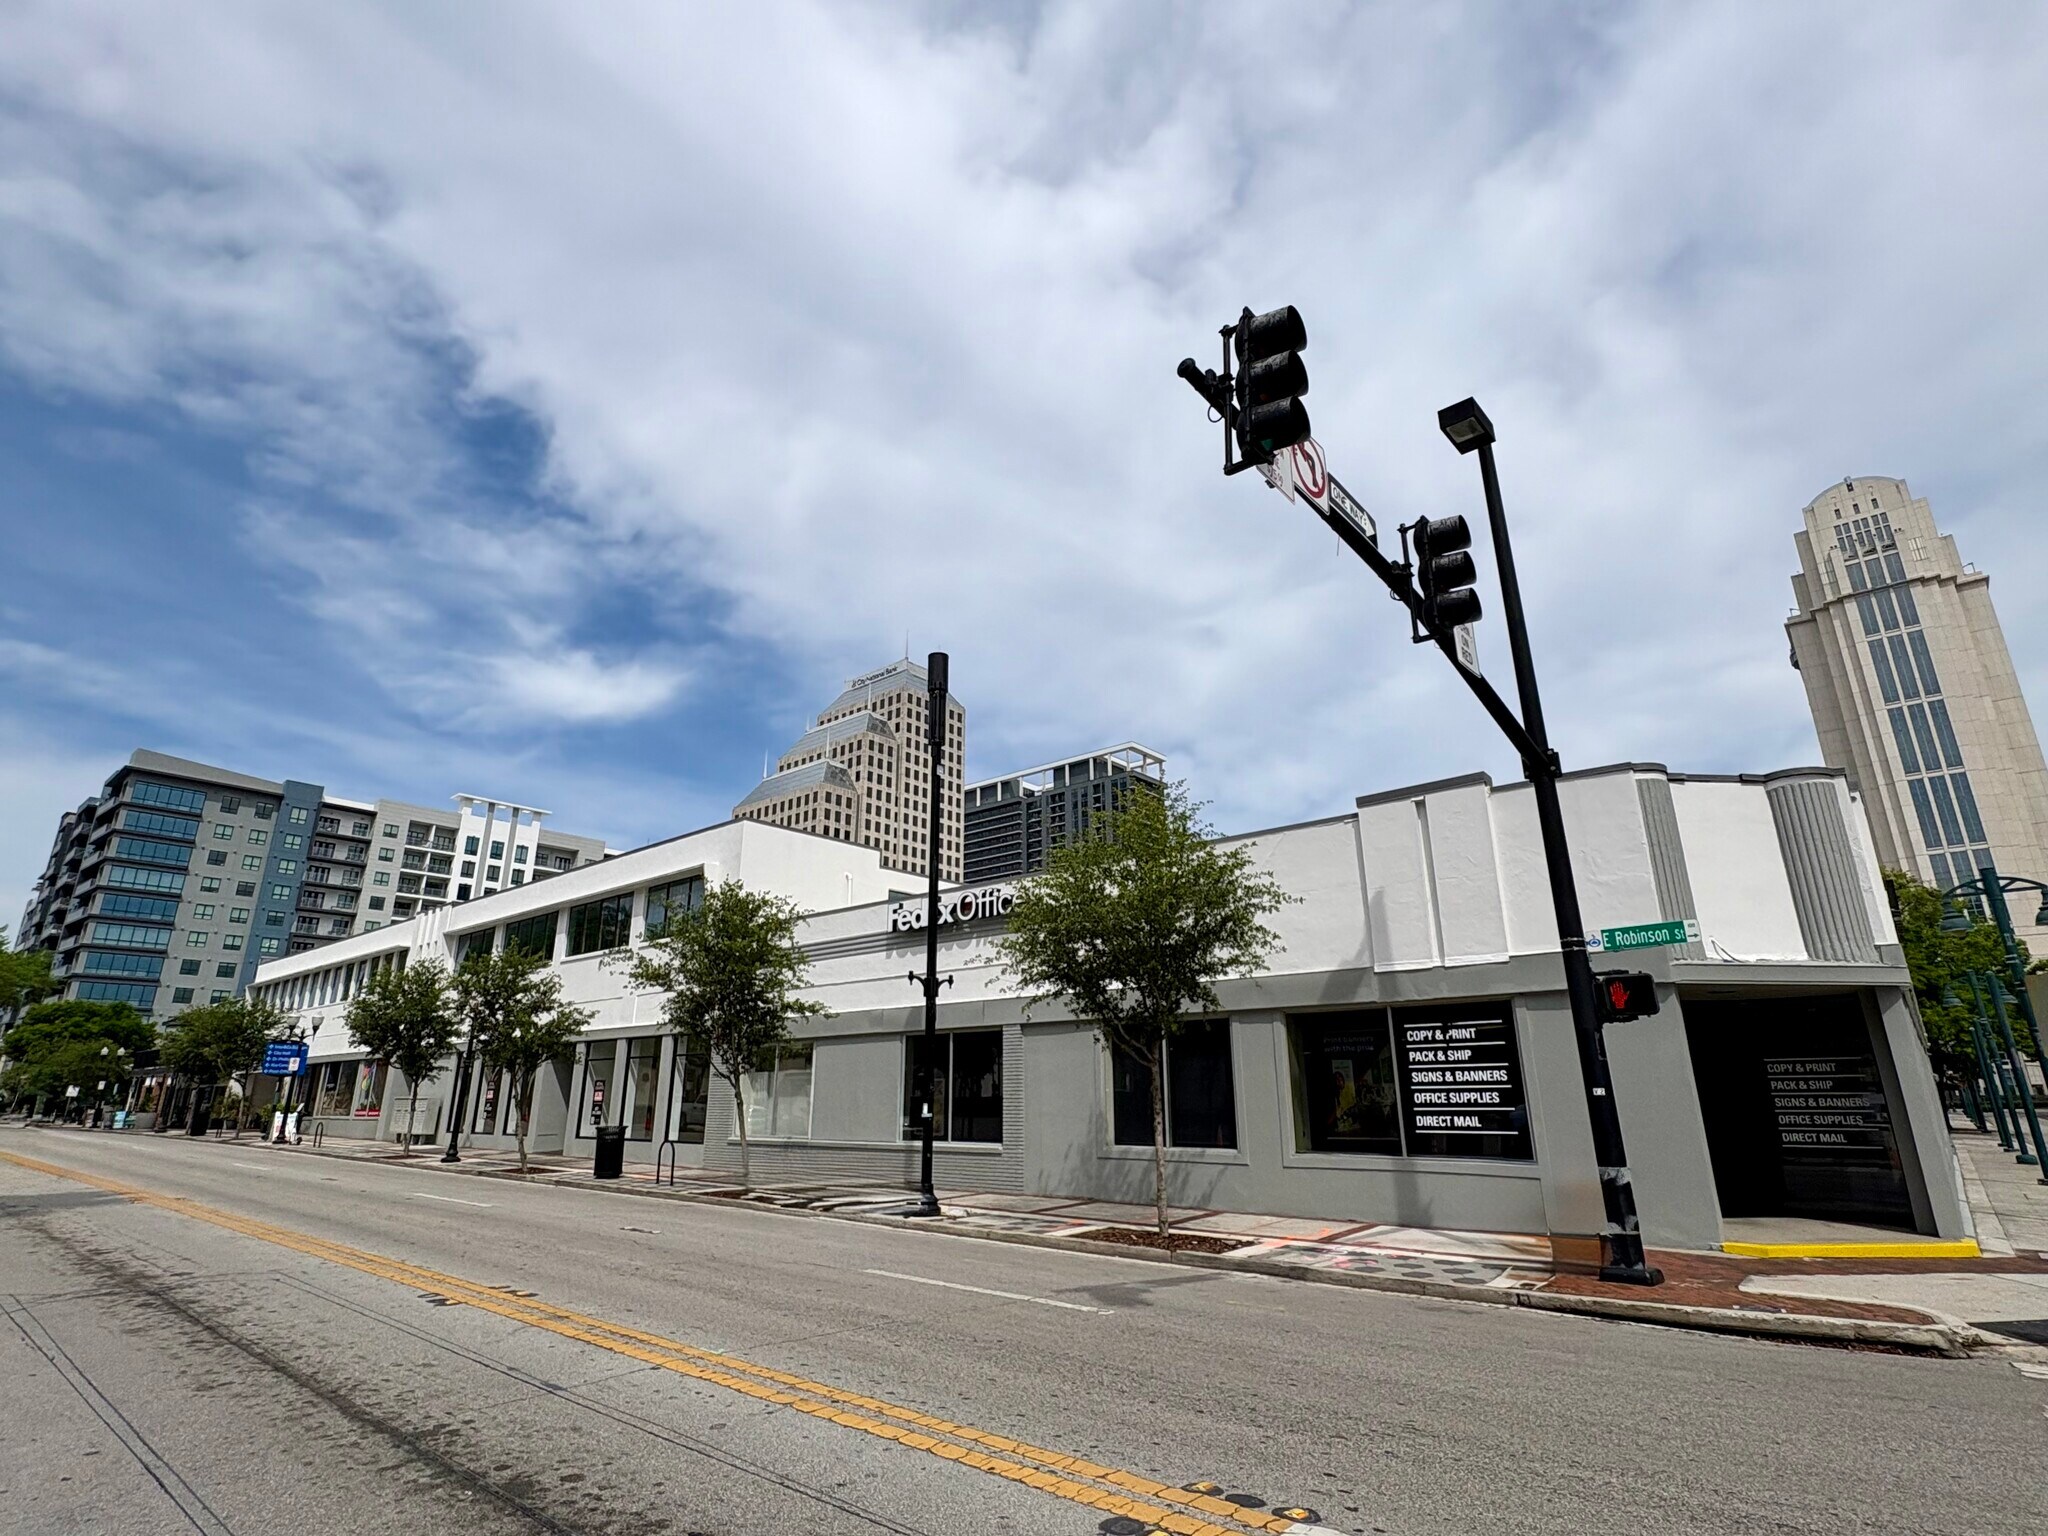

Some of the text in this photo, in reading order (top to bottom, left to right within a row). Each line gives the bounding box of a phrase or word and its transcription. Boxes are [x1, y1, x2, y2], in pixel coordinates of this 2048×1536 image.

[1602, 928, 1686, 947] E Robinson St
[1407, 1028, 1477, 1041] COPY & PRINT
[1409, 1050, 1472, 1062] PACK & SHIP
[1767, 1063, 1836, 1073] COPY & PRINT
[1411, 1070, 1508, 1083] SIGNS & BANNERS
[1770, 1080, 1833, 1090] PACK & SHIP
[1414, 1091, 1500, 1104] OFFICE SUPPLIES
[1774, 1097, 1870, 1107] SIGNS & BANNERS
[1416, 1115, 1482, 1127] DIRECT MAIL
[1778, 1115, 1863, 1125] OFFICE SUPPLIES
[1782, 1132, 1848, 1143] DIRECT MAIL
